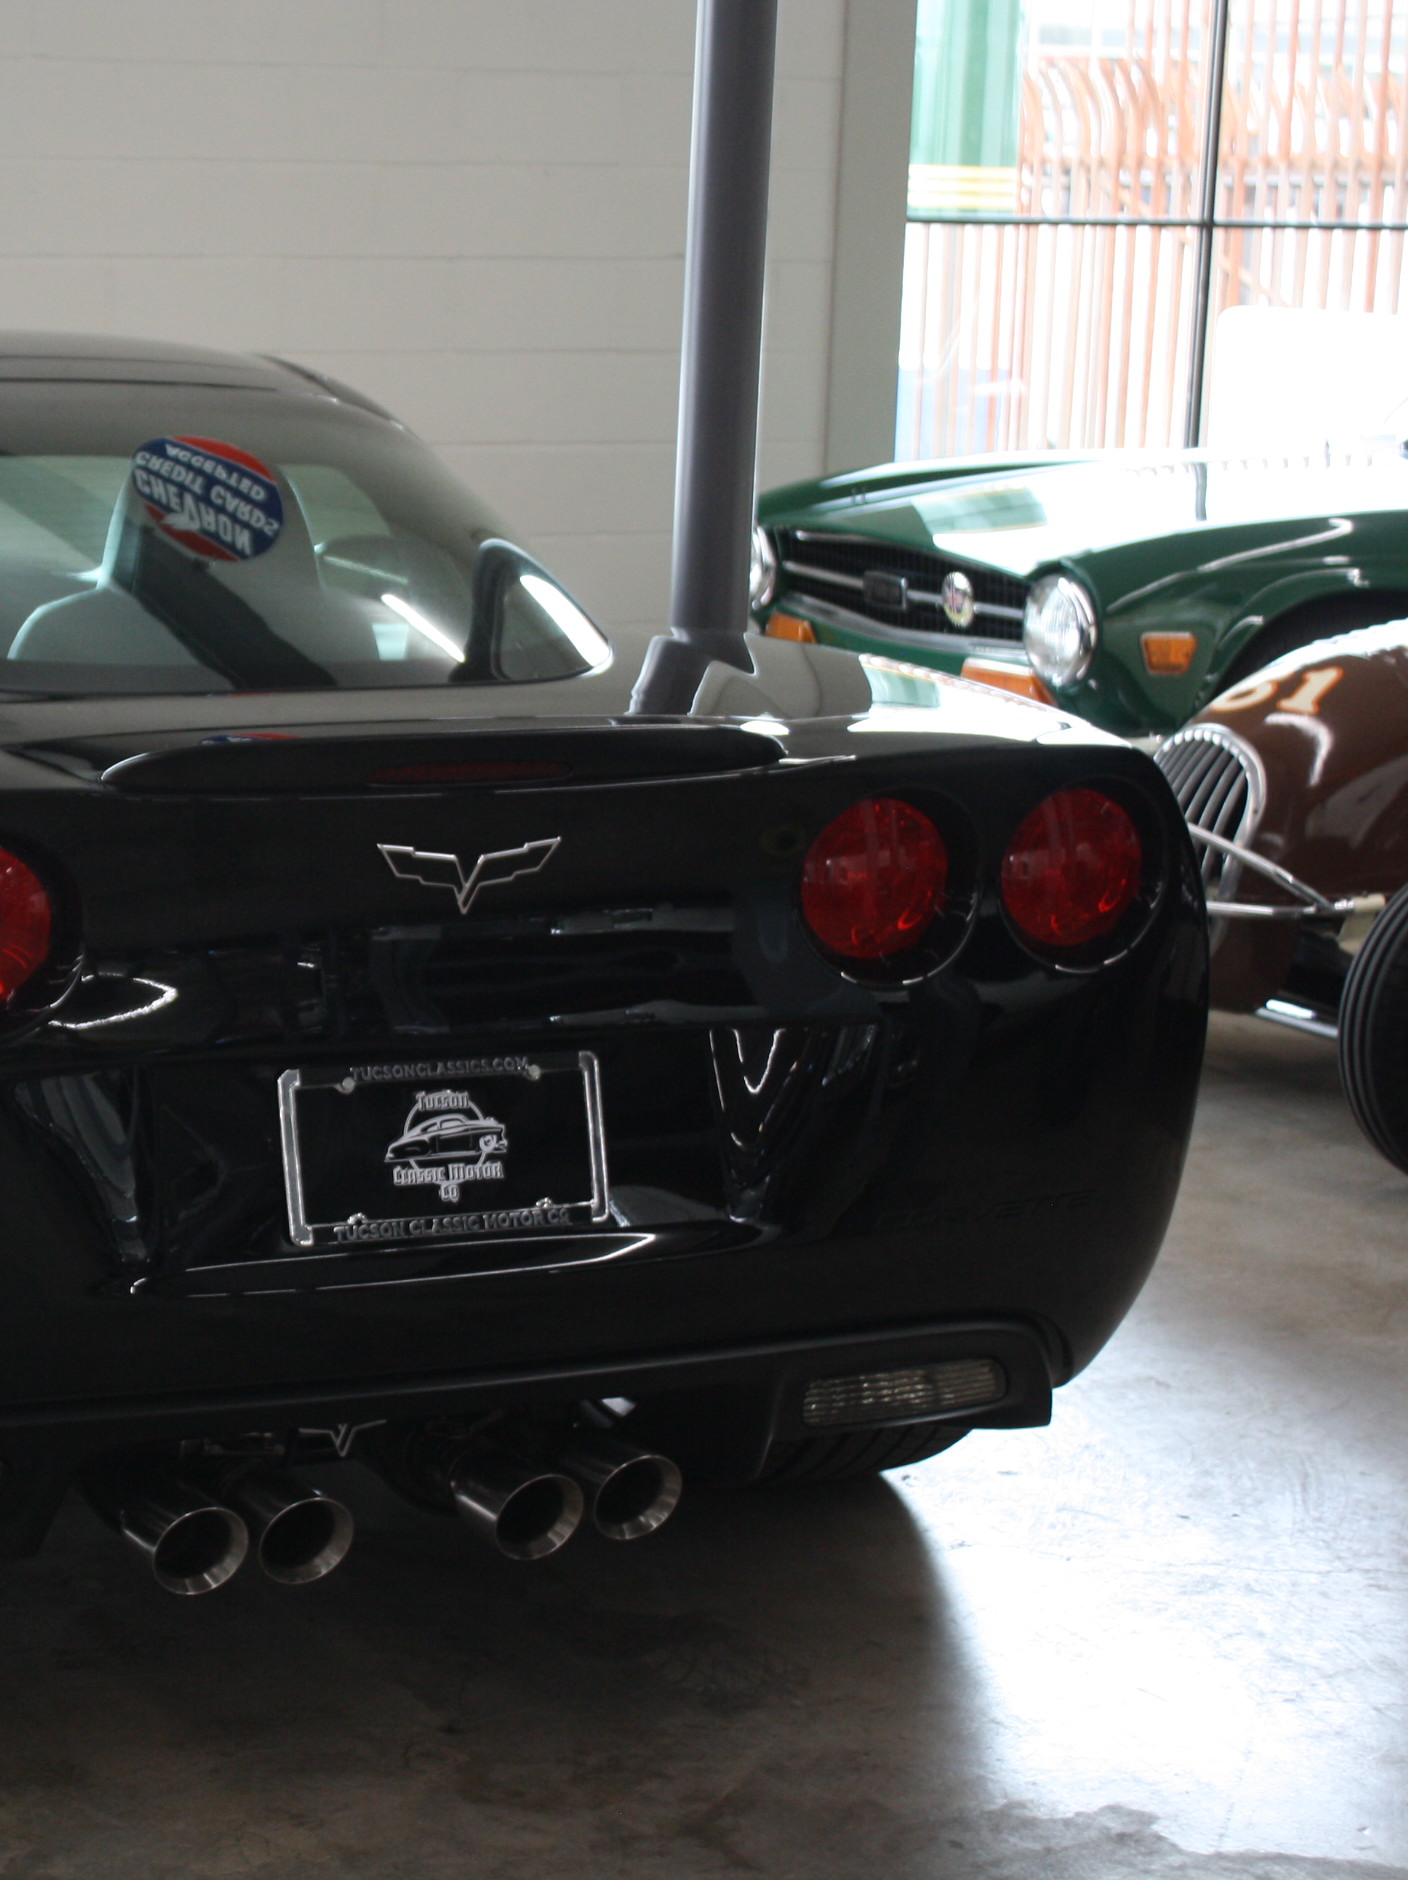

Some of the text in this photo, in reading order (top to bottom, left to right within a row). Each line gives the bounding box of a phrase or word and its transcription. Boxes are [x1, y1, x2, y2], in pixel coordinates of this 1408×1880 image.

[351, 1055, 529, 1080] TUCSONCLASSICS.COM
[333, 1221, 408, 1243] TUCSON
[409, 1215, 481, 1235] CLASSIC
[483, 1210, 543, 1231] MOTOR
